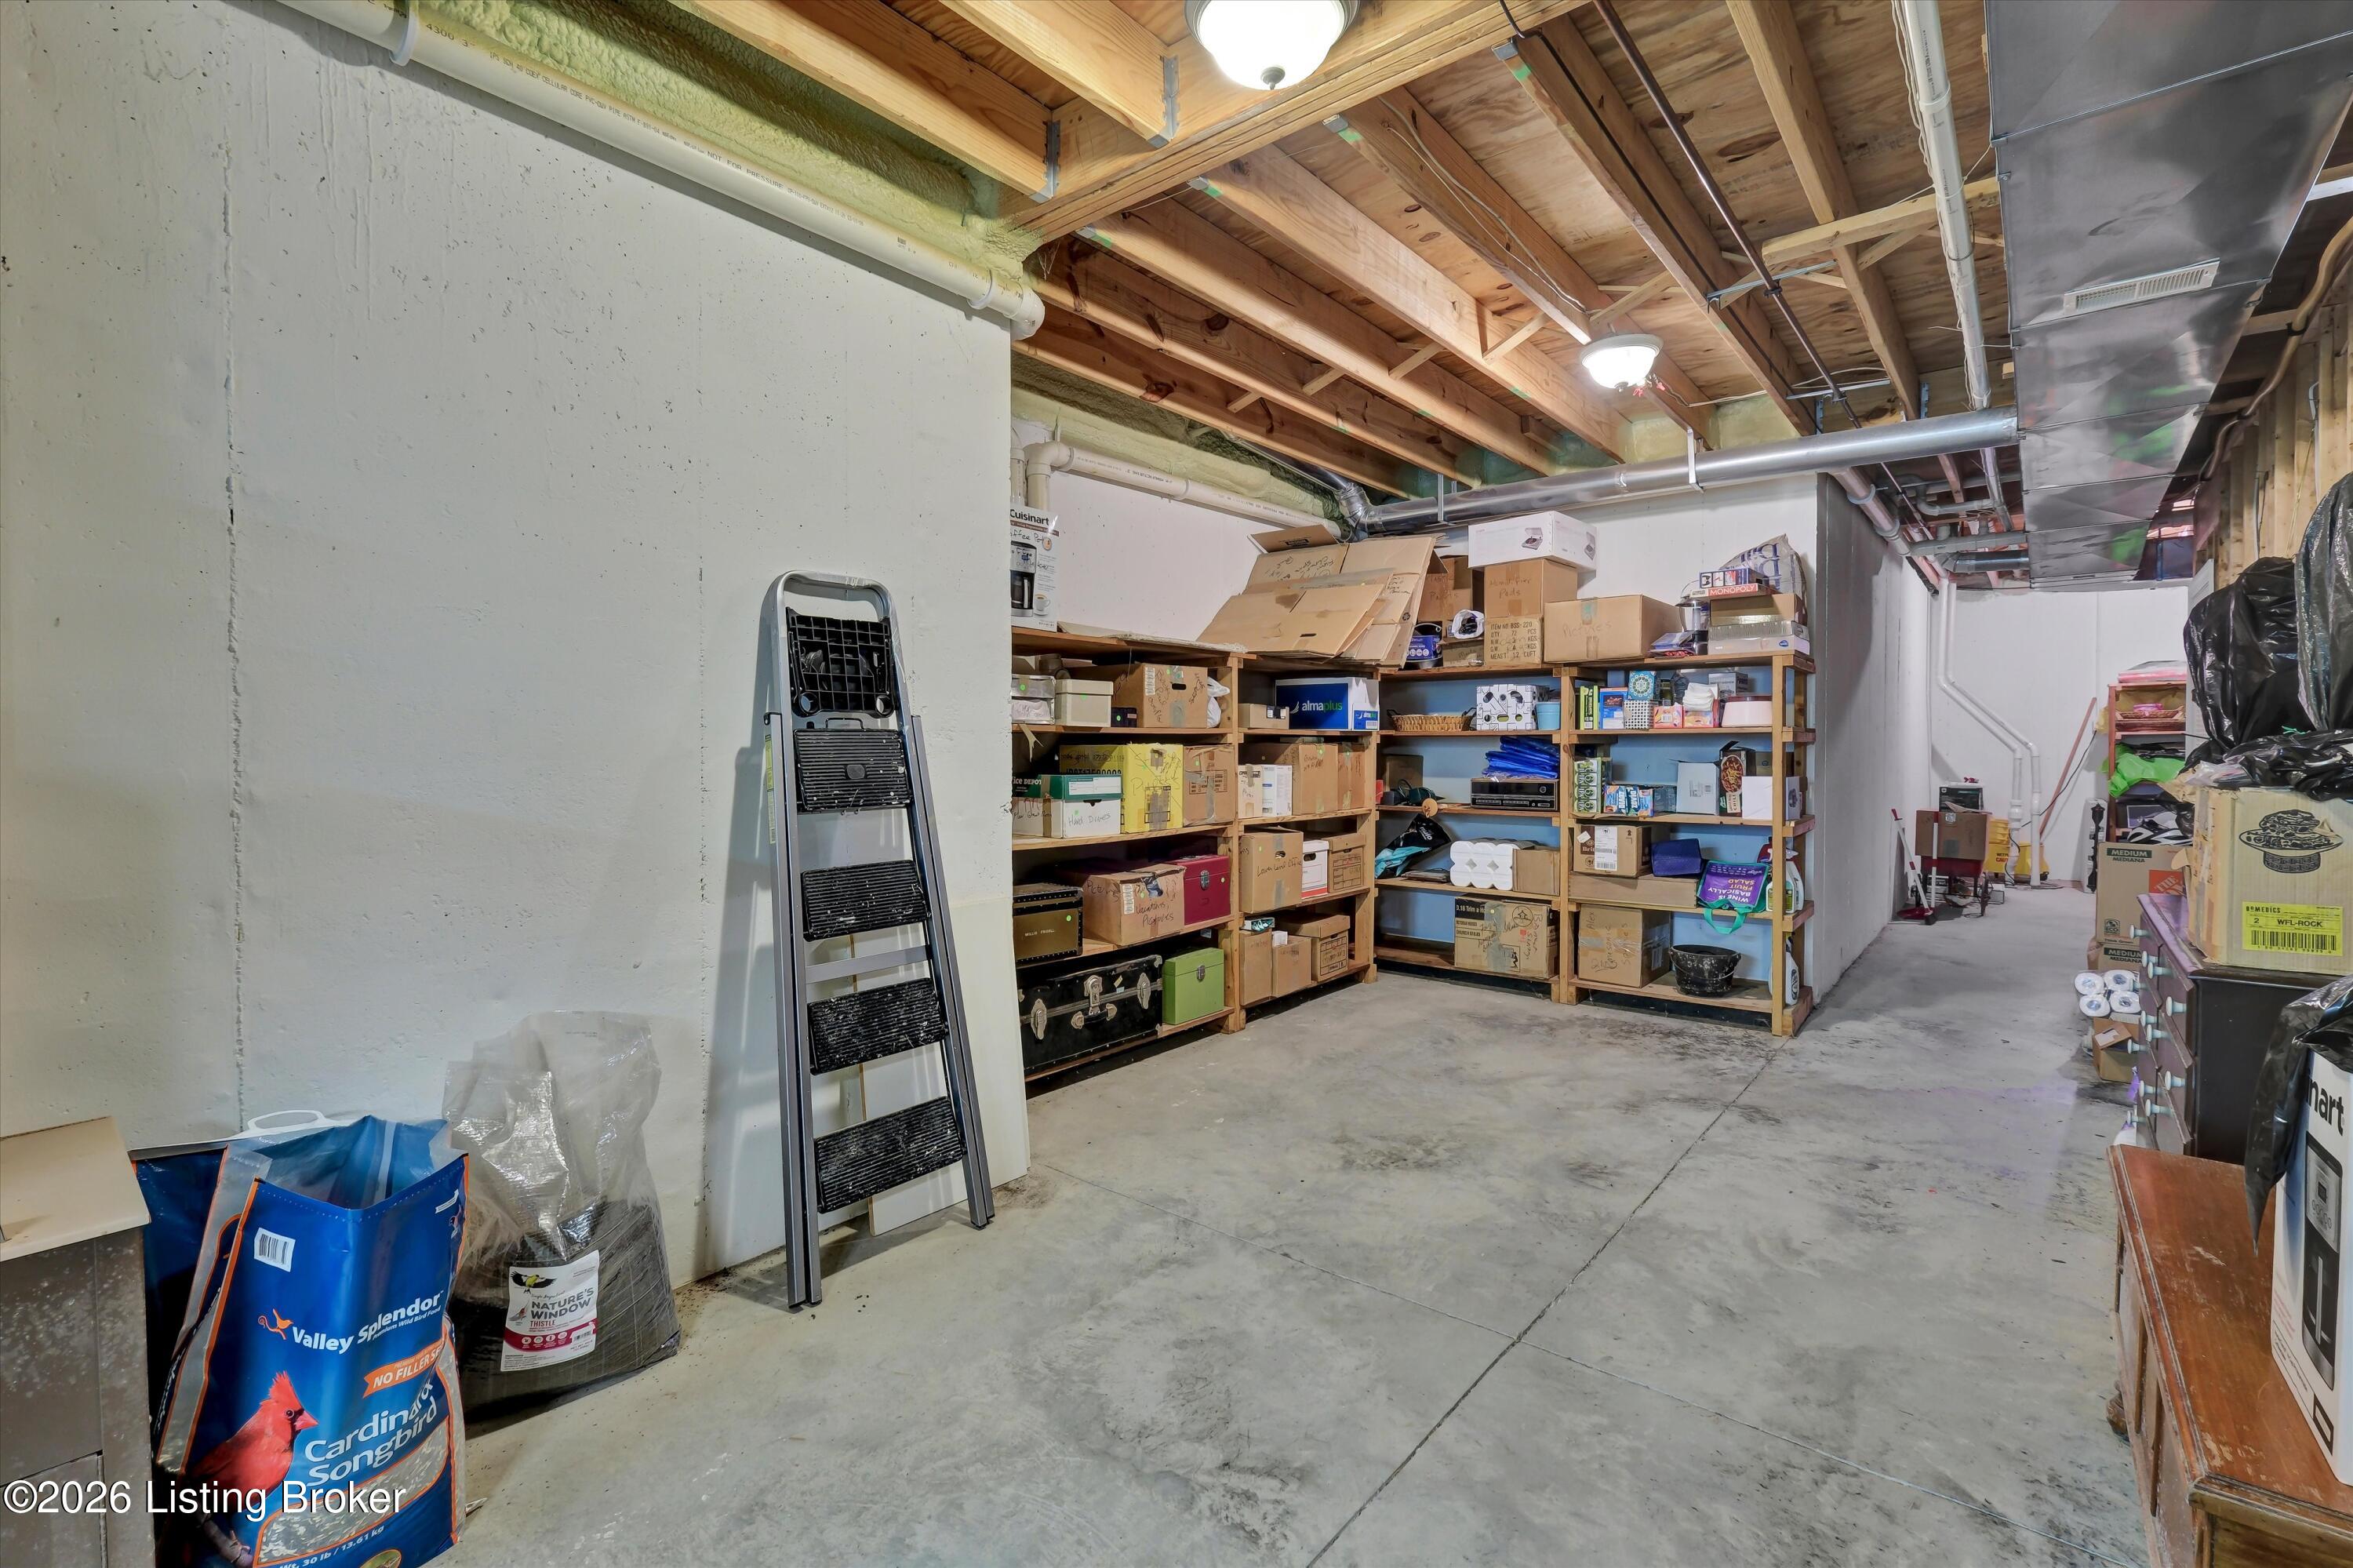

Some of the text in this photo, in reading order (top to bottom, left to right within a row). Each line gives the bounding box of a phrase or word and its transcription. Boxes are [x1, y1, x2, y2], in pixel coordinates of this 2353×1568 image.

[426, 24, 455, 41] 4300
[541, 75, 568, 92] CELLULAR
[570, 88, 583, 100] CORE
[609, 106, 621, 117] PIPE
[623, 113, 636, 122] ASTM
[707, 151, 784, 189] NOT FOR PRESSURE
[1010, 509, 1049, 526] Cuisinart
[1710, 584, 1755, 596] MONOPOLY
[1302, 700, 1343, 712] almaplus
[1068, 813, 1111, 826] Hard Drives
[1707, 887, 1751, 897] BASICALLY
[2155, 875, 2179, 892] THE
[1586, 911, 1595, 930] Alex
[2277, 919, 2323, 928] WFL-ROCK
[2309, 1078, 2344, 1137] nart
[531, 1298, 591, 1319] WINDOW
[532, 1287, 595, 1310] NATURE'S
[292, 1293, 443, 1355] Valley Splendor
[372, 1306, 442, 1341] Premium Wild Bird Food
[373, 1372, 393, 1388] NO
[395, 1354, 429, 1381] FILLER
[307, 1396, 437, 1486] Songbird
[303, 1556, 318, 1565] 30
[319, 1551, 332, 1562] lb
[341, 1533, 369, 1552] 13.61
[371, 1526, 384, 1538] kg
